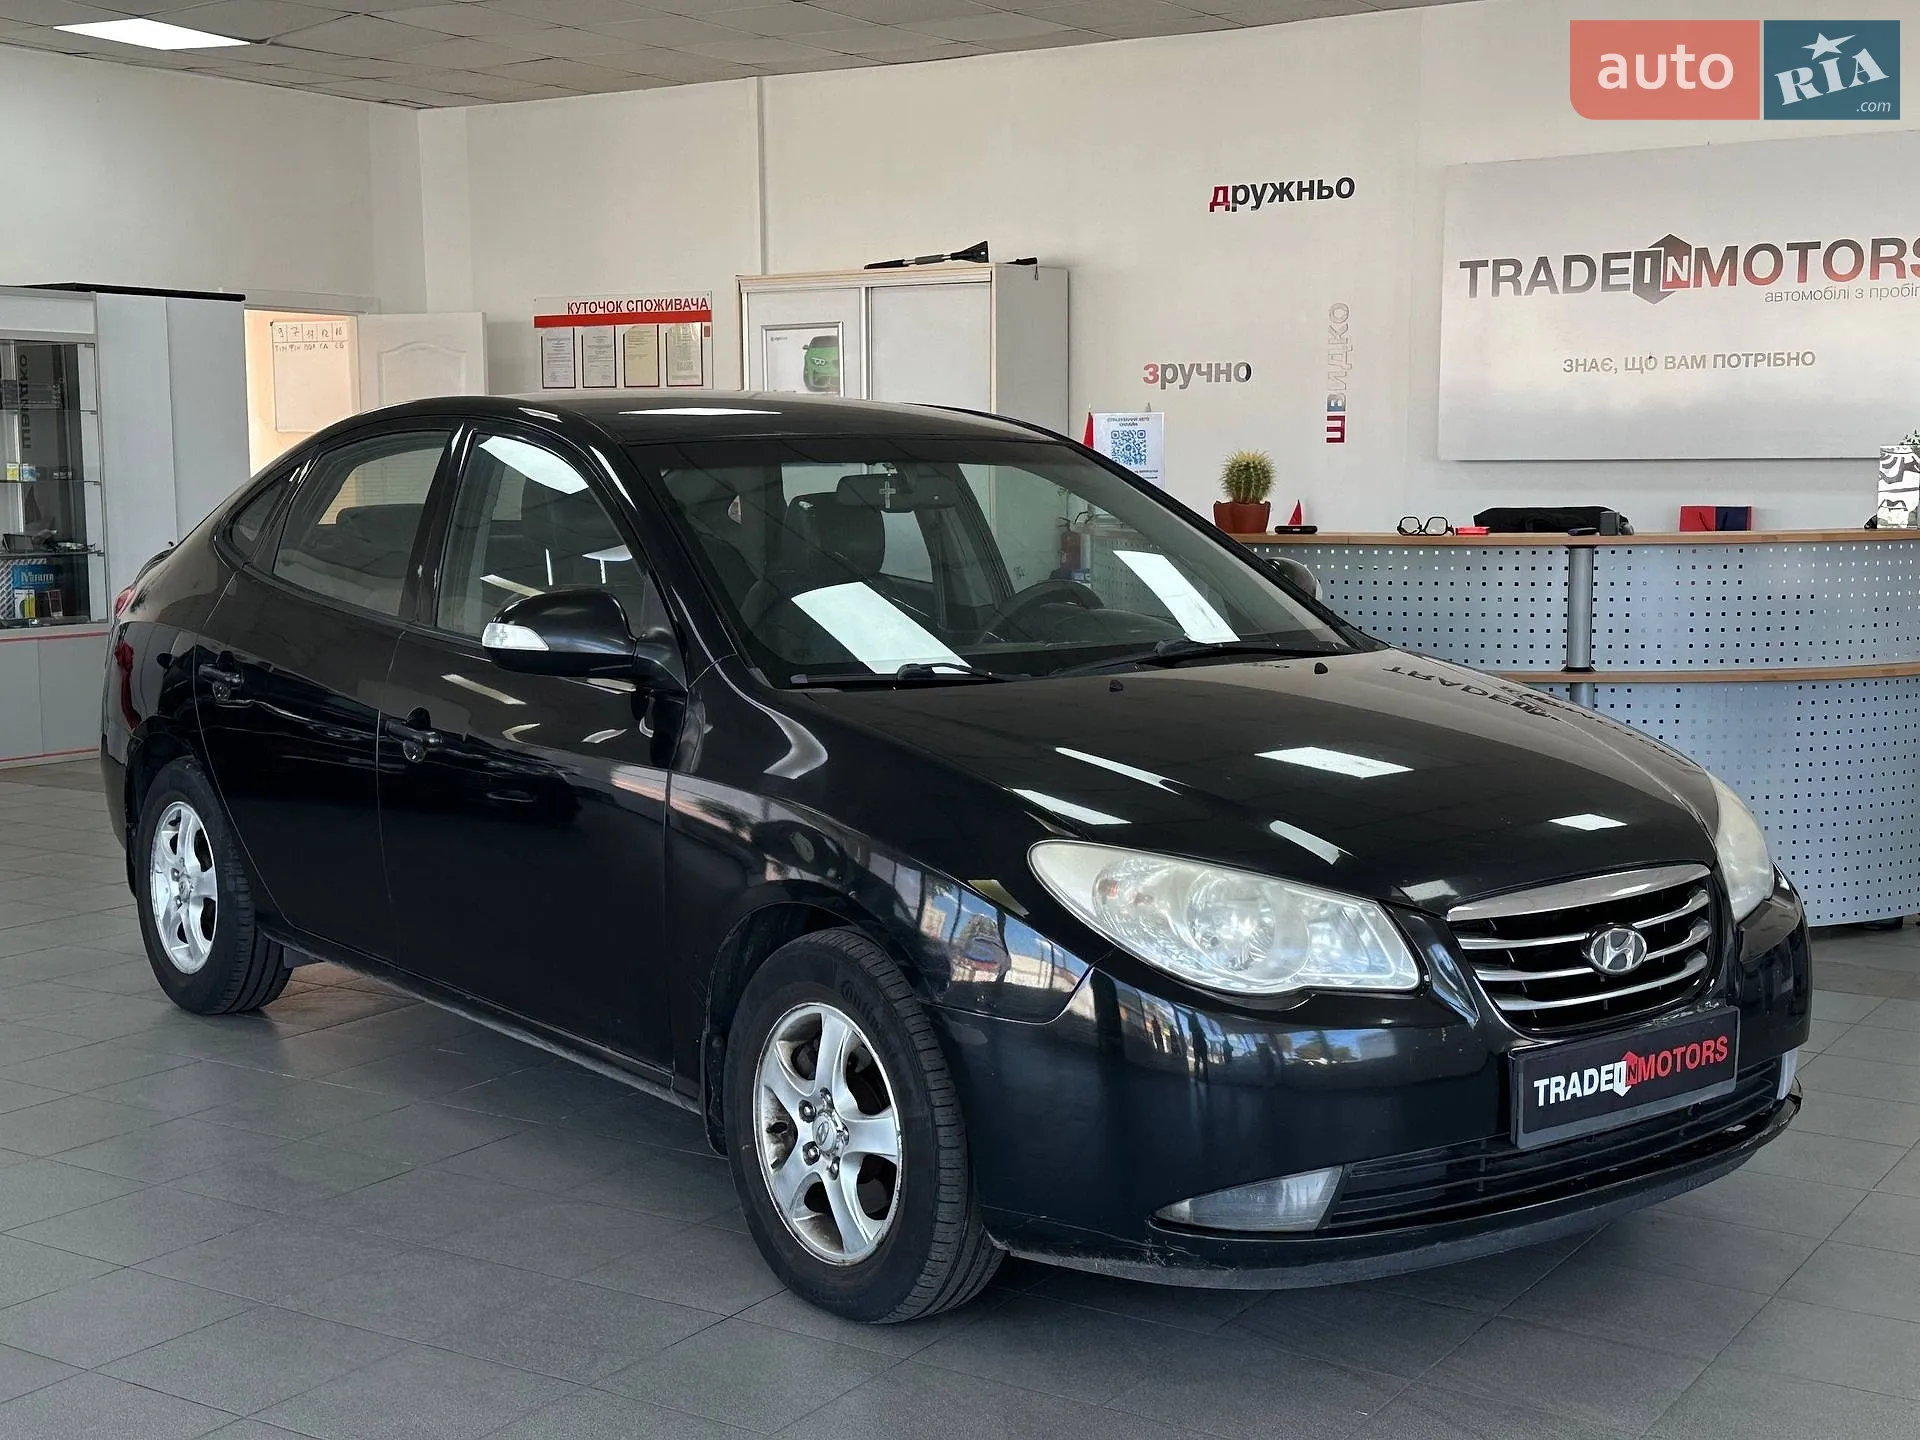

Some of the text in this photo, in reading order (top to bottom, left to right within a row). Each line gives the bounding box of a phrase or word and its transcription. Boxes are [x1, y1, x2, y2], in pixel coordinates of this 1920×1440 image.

[1208, 176, 1356, 213] дружньо
[567, 297, 709, 315] КУТОЧОК СПОЖИВАЧА
[1765, 285, 1850, 303] автомобілі
[1855, 287, 1864, 299] з
[1142, 359, 1252, 390] зручно
[1562, 350, 1817, 375] ЗНАЄ, ЩО ВАМ ПОТРІБНО
